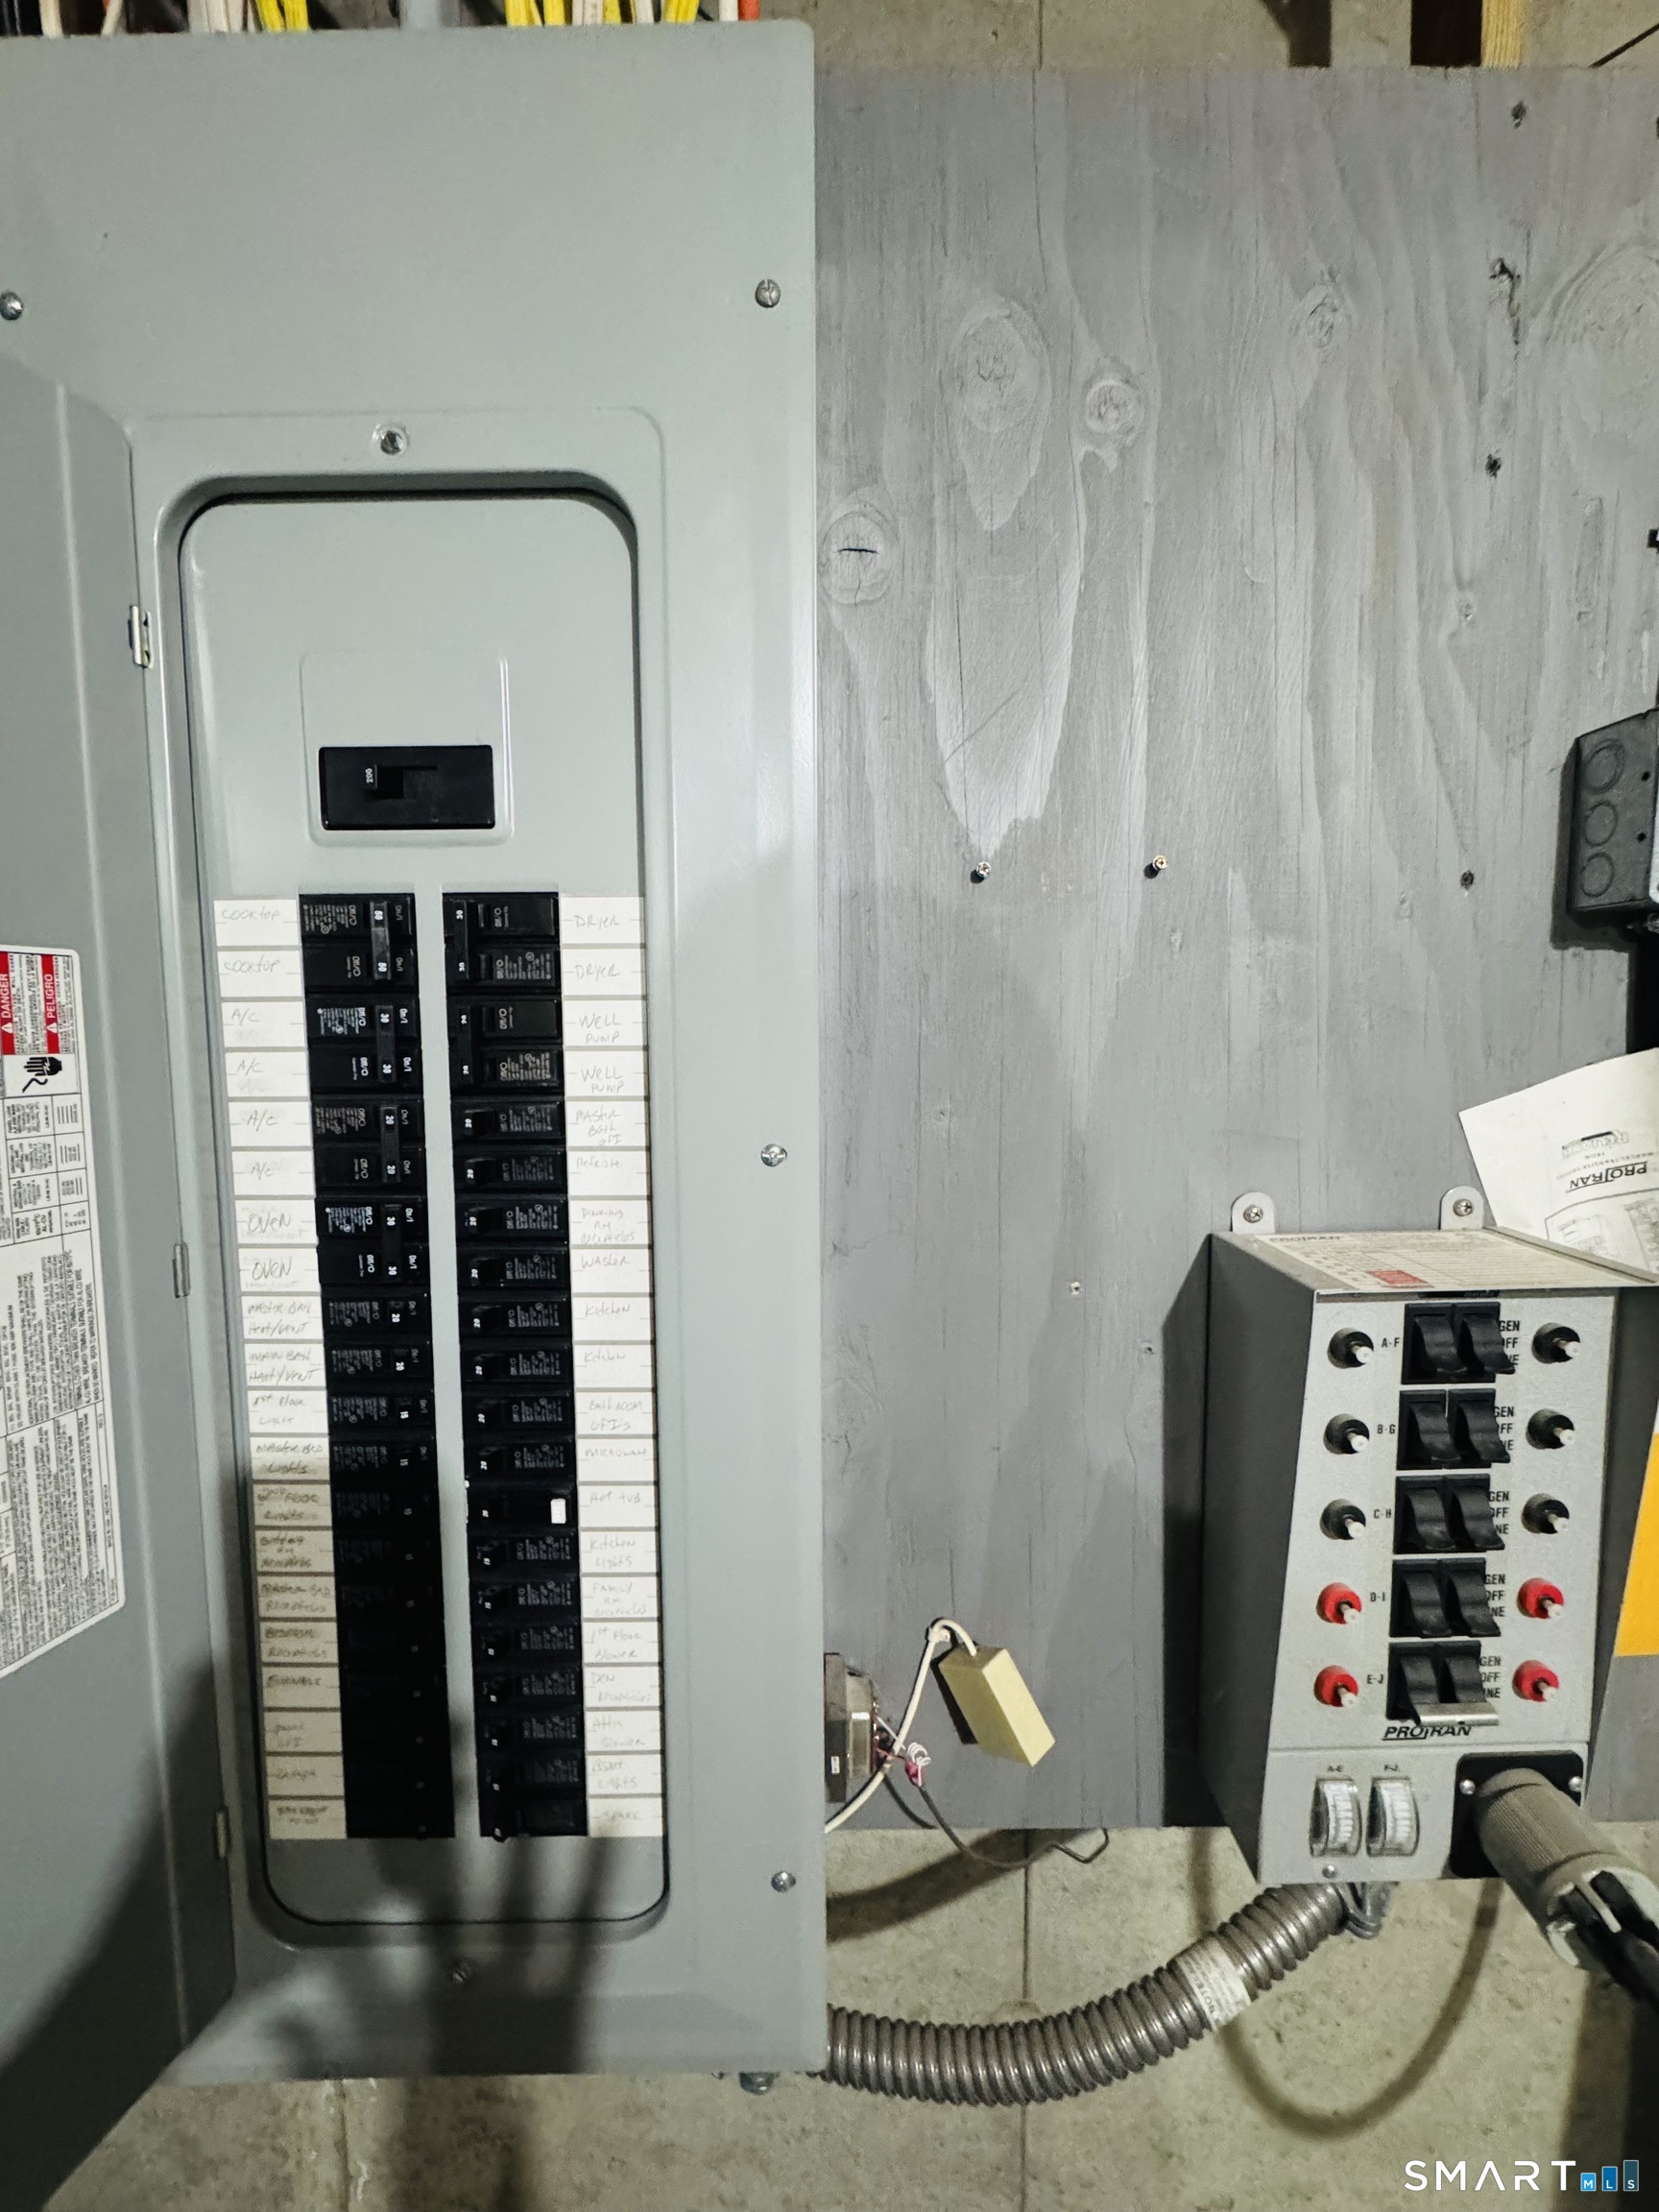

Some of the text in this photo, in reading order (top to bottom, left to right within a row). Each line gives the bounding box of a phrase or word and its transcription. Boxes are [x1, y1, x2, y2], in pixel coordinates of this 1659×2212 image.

[365, 768, 373, 783] 200
[455, 909, 464, 920] 30
[0, 973, 11, 1019] DANGER
[45, 974, 55, 1019] PELIGRO
[380, 1013, 390, 1023] 30
[382, 1064, 392, 1074] 30
[385, 1115, 395, 1125] 20
[465, 1118, 472, 1128] 20
[386, 1165, 396, 1175] 20
[467, 1168, 474, 1179] 20
[1567, 1161, 1647, 1192] PROTRAN
[386, 1216, 396, 1226] 30
[469, 1216, 477, 1226] 20
[388, 1265, 397, 1276] 30
[470, 1268, 479, 1279] 20
[391, 1313, 400, 1323] 20
[473, 1318, 481, 1329] 20
[1499, 1320, 1521, 1332] GEN
[396, 1361, 405, 1371] 20
[475, 1365, 483, 1376] 20
[400, 1410, 409, 1419] 15
[1493, 1407, 1515, 1417] GEN
[477, 1413, 486, 1424] 20
[480, 1460, 488, 1471] 20
[1488, 1491, 1510, 1503] GEN
[1485, 1574, 1506, 1585] GEN
[1479, 1656, 1502, 1667] GEN
